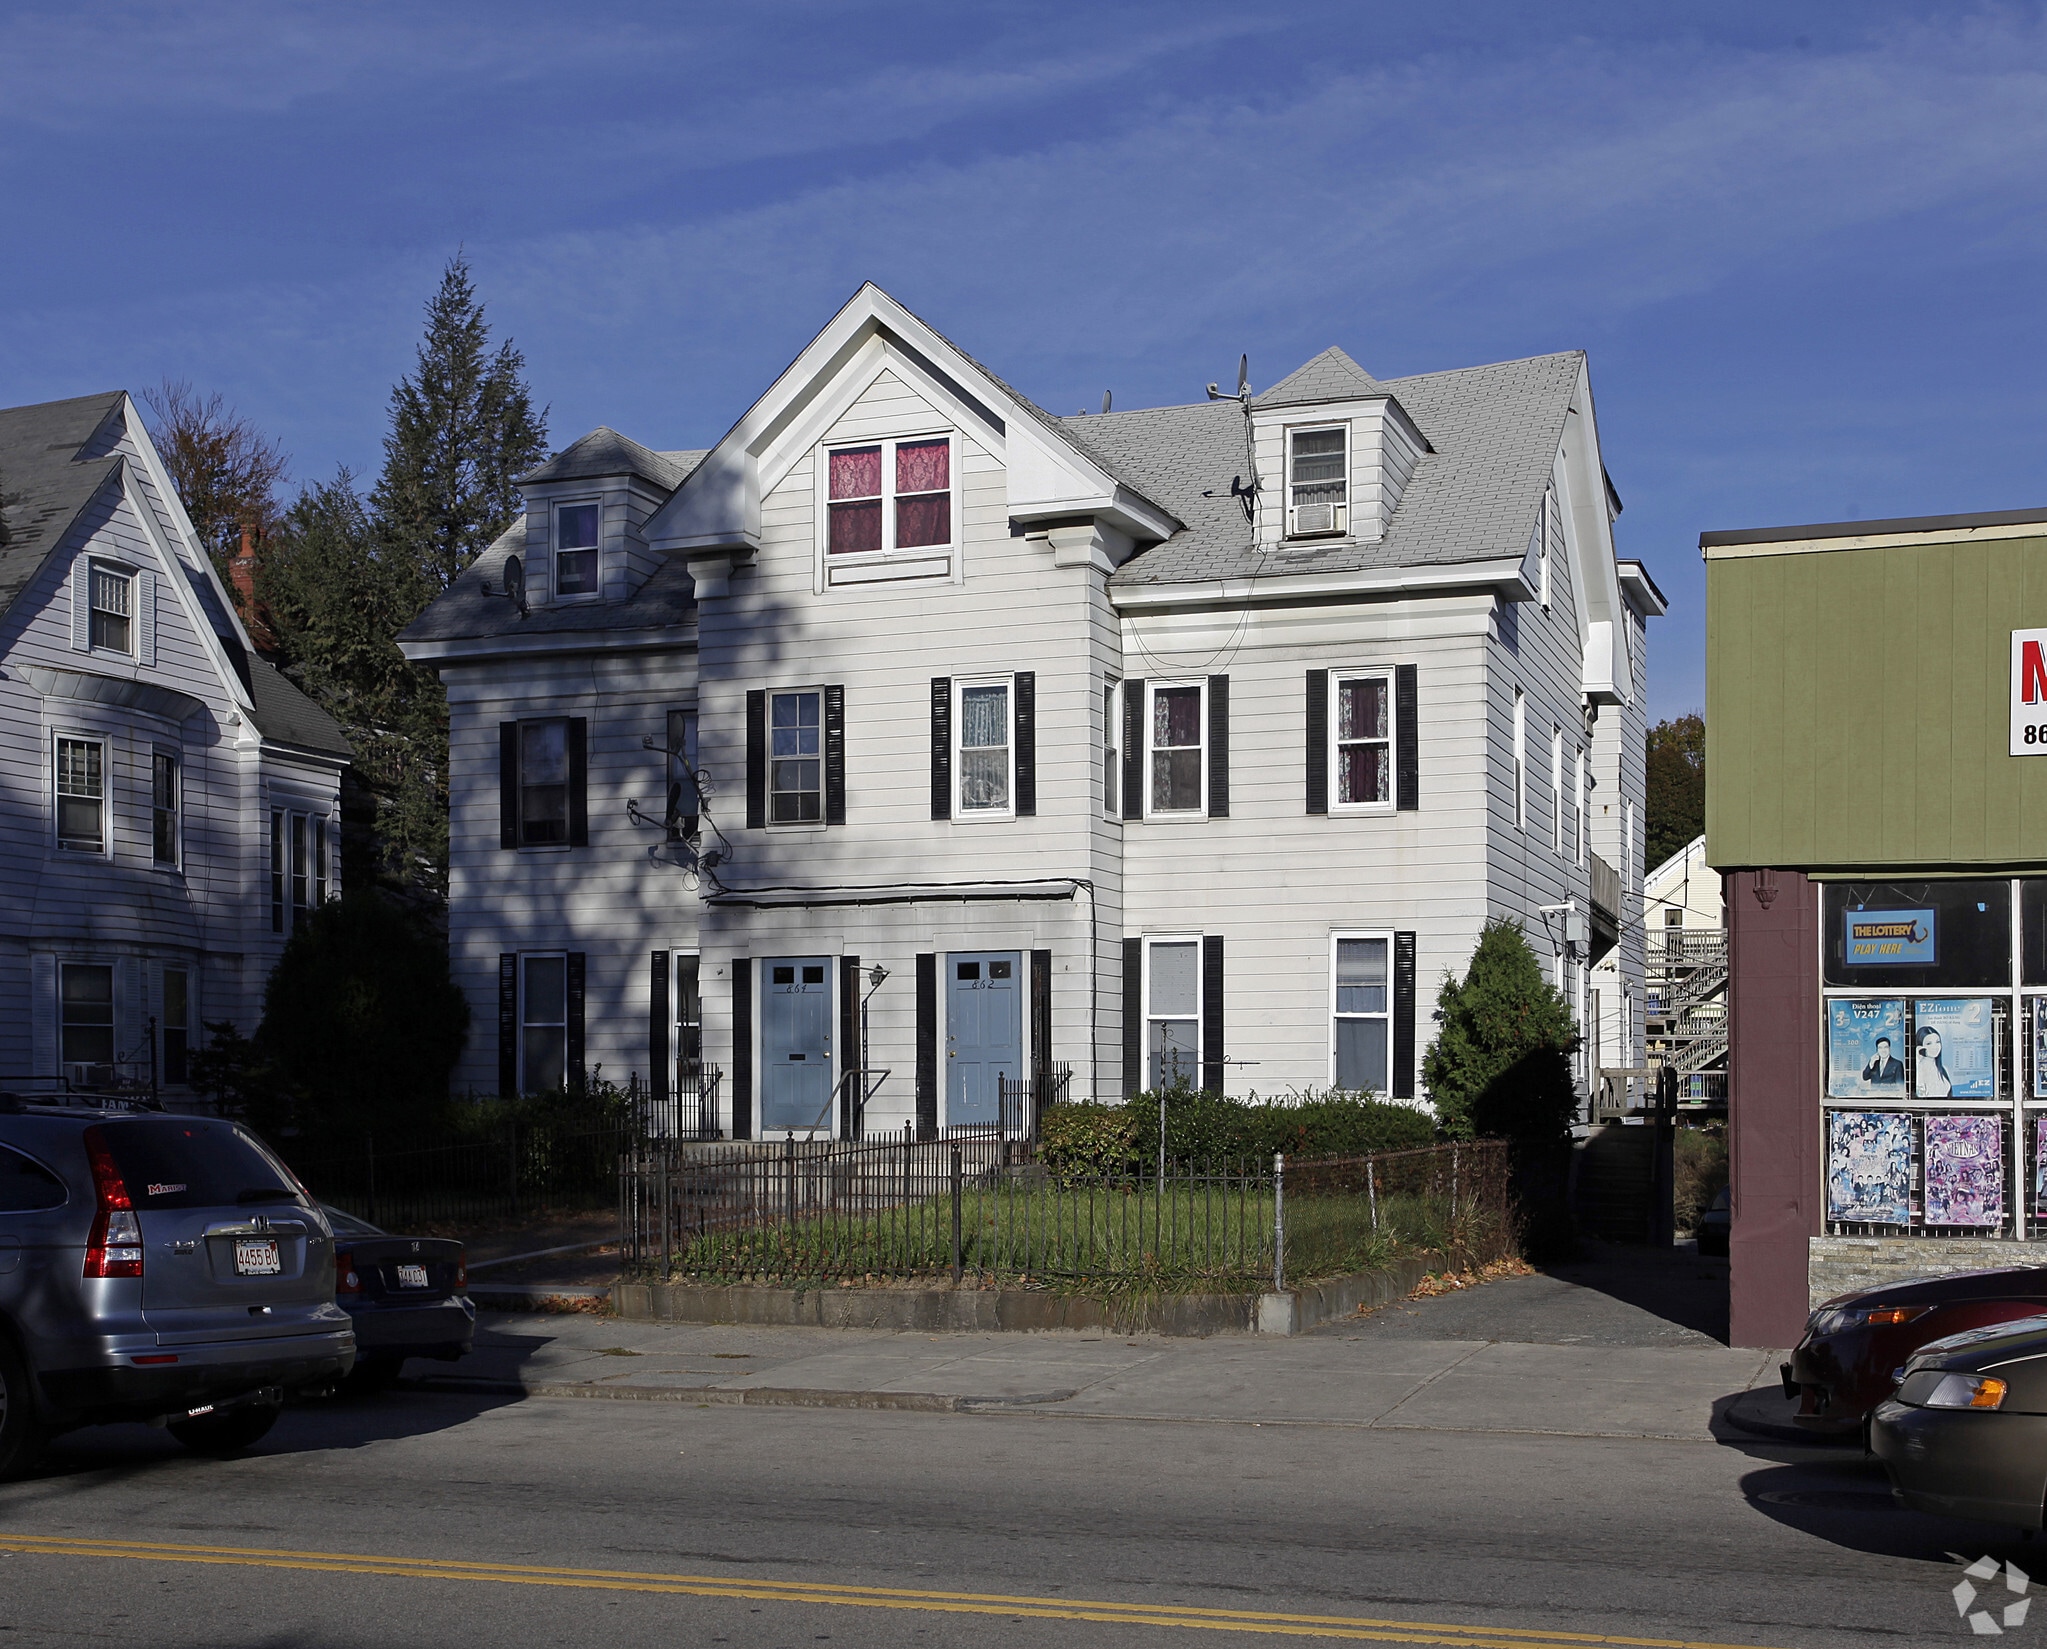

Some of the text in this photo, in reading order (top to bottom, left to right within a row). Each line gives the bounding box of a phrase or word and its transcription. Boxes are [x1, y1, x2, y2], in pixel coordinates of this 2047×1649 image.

[1854, 924, 1913, 937] THE LOTTERY
[1853, 943, 1903, 955] PLAY HERE
[786, 983, 808, 994] 864
[971, 979, 995, 990] 862
[1854, 1010, 1881, 1019] V247
[238, 1249, 264, 1266] 4455
